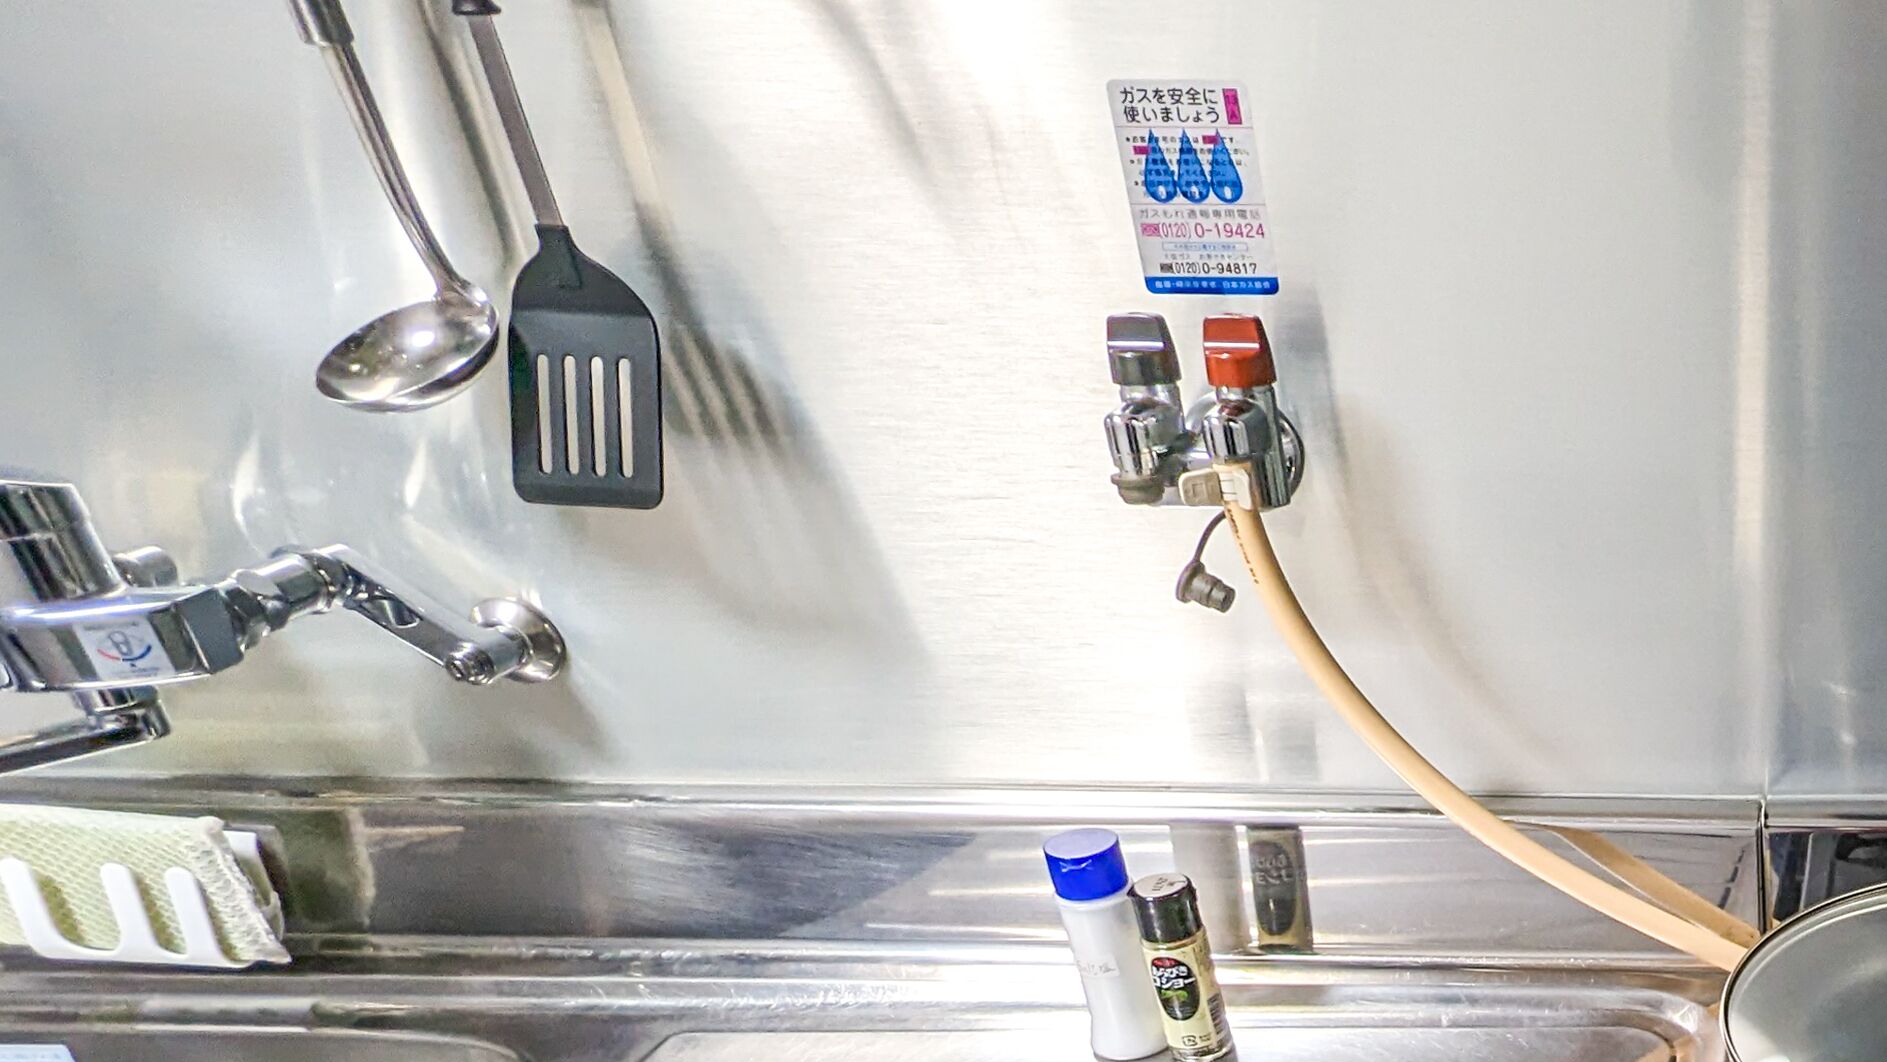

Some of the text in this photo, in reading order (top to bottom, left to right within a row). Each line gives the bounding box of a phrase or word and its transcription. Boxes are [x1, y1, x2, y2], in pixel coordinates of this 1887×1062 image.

[1120, 86, 1218, 105] ガスを安全に
[1123, 106, 1220, 124] 使いましょう
